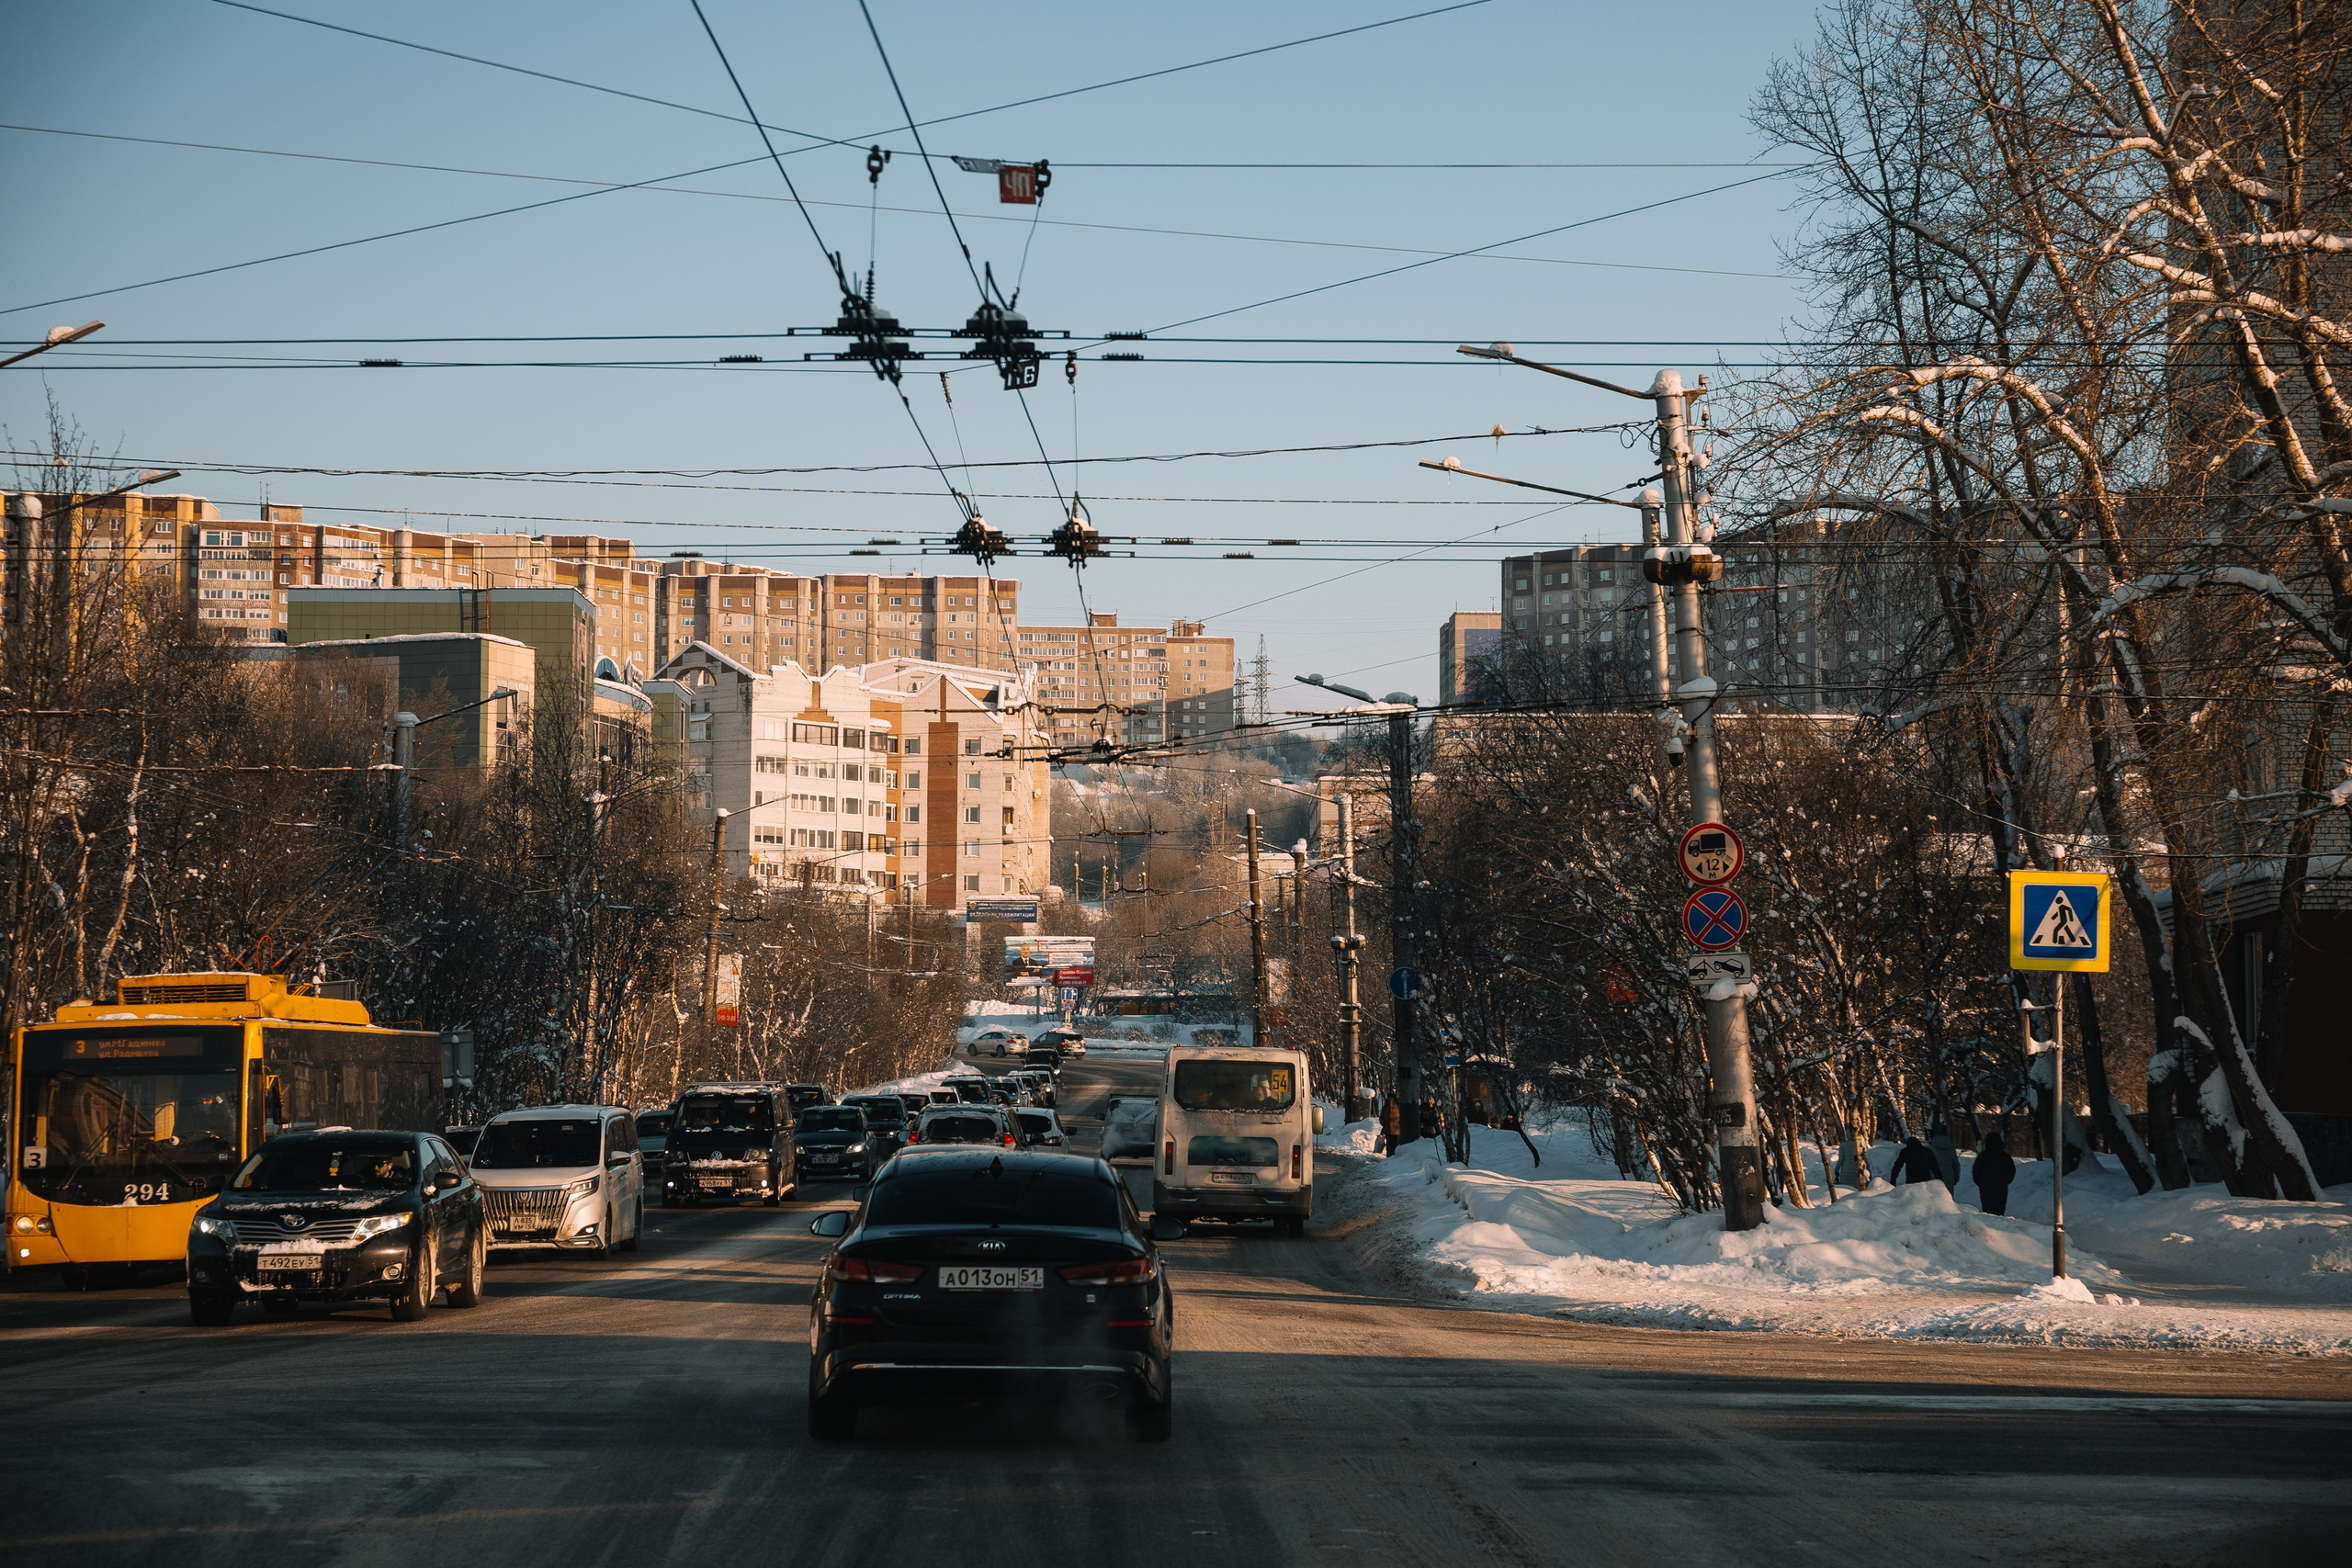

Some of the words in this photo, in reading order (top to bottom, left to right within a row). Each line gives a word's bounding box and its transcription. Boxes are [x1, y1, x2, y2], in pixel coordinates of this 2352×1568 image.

[1003, 170, 1031, 197] ЧП
[1705, 858, 1720, 871] 12
[75, 1040, 85, 1054] 3
[1272, 1074, 1287, 1090] 54
[28, 1152, 41, 1168] 3
[123, 1182, 170, 1201] 294
[262, 1258, 305, 1268] Т492ЕУ
[308, 1257, 319, 1265] 51
[945, 1269, 1015, 1286] А013ОН
[1021, 1269, 1039, 1282] 51
